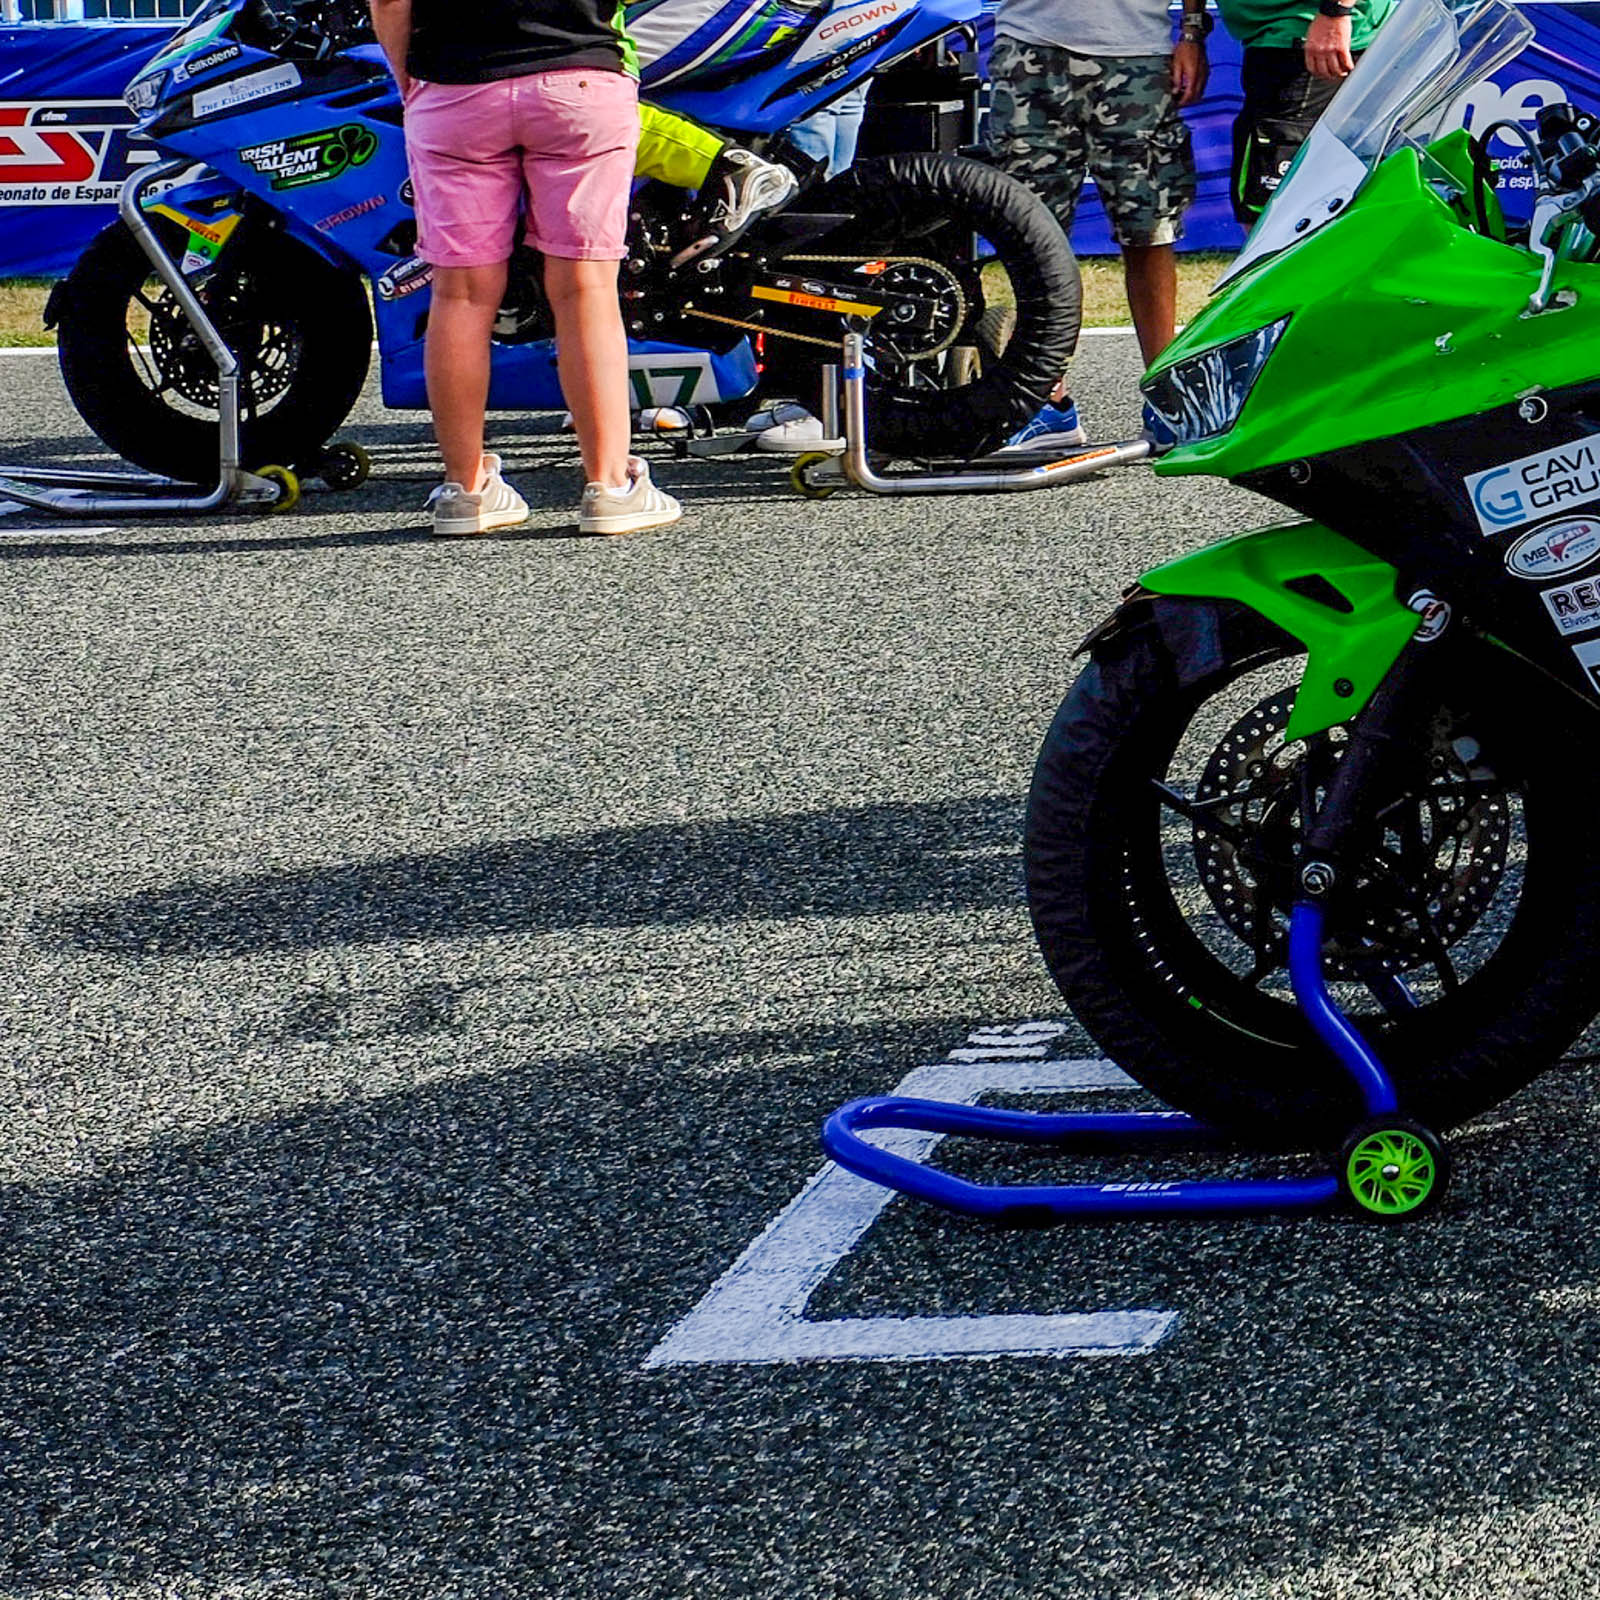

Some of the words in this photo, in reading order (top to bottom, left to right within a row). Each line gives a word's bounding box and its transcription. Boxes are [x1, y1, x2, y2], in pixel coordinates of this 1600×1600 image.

[818, 1, 898, 41] CROWN
[187, 45, 240, 75] Silkolene
[240, 142, 286, 162] IRISH
[253, 145, 321, 172] TALENT
[280, 160, 318, 179] TEAM
[62, 183, 73, 199] de
[75, 183, 121, 202] Españ
[788, 293, 837, 311] PIRELLI
[1521, 446, 1596, 486] CAVI
[1522, 547, 1549, 565] MB
